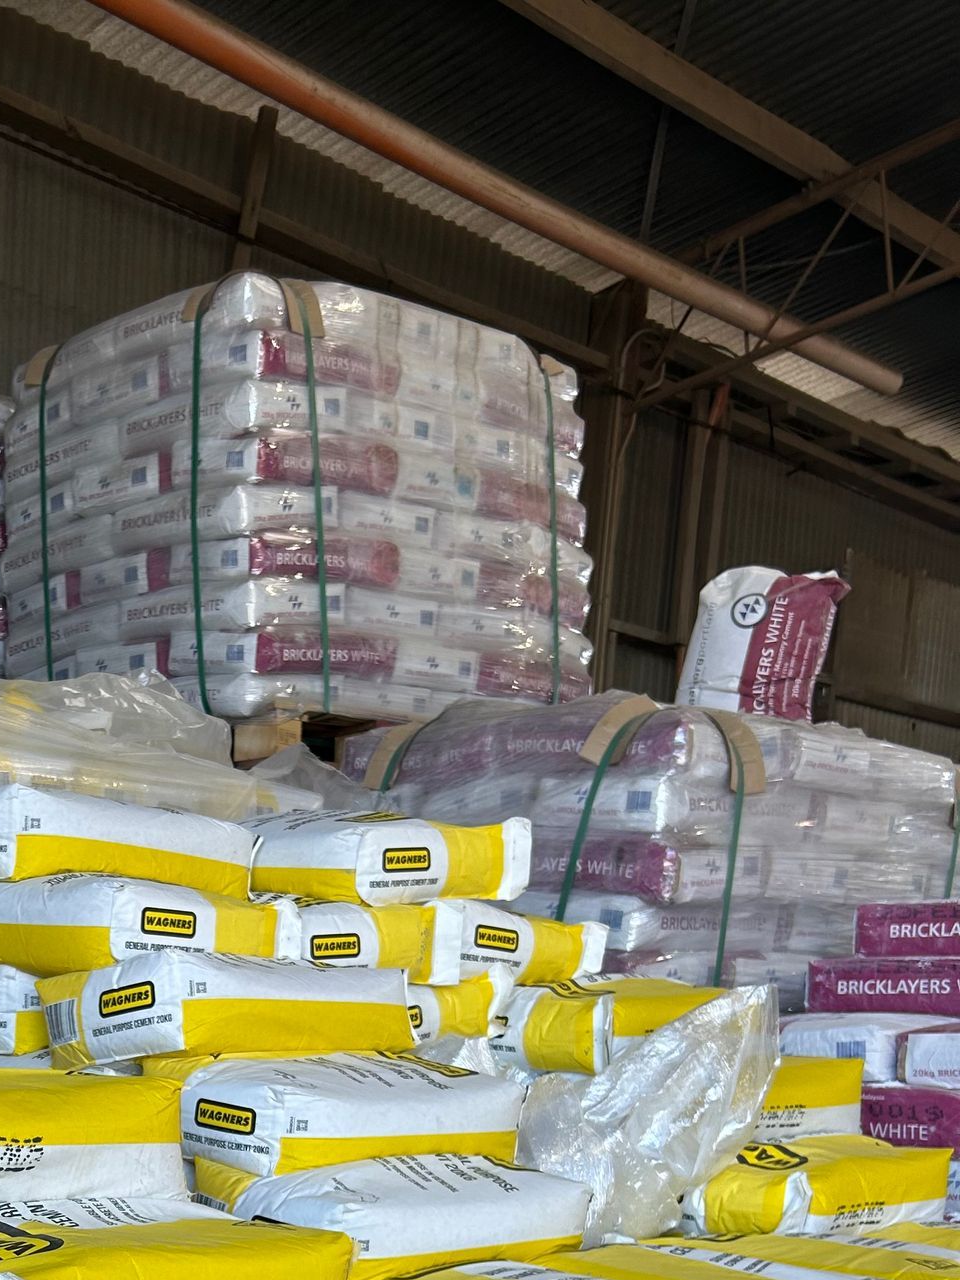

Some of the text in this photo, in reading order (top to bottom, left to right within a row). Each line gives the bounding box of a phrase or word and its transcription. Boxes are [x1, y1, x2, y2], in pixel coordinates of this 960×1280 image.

[765, 597, 788, 644] WHITE
[386, 855, 427, 865] WAGNERS
[588, 860, 634, 879] WHITE
[369, 880, 390, 888] GENERAL
[146, 916, 193, 929] WAGNERS
[125, 941, 149, 950] GENERAL
[314, 941, 357, 952] WAGNERS
[478, 932, 516, 945] WAGNERS
[837, 979, 950, 995] BRICKLAYERS
[103, 990, 149, 1009] WAGNERS
[92, 1013, 173, 1038] GENERAL PURPOSE CEMENT 20KG
[200, 1107, 250, 1126] WAGNERS
[183, 1132, 270, 1155] GENERAL PURPOSE CEMENT 20KG
